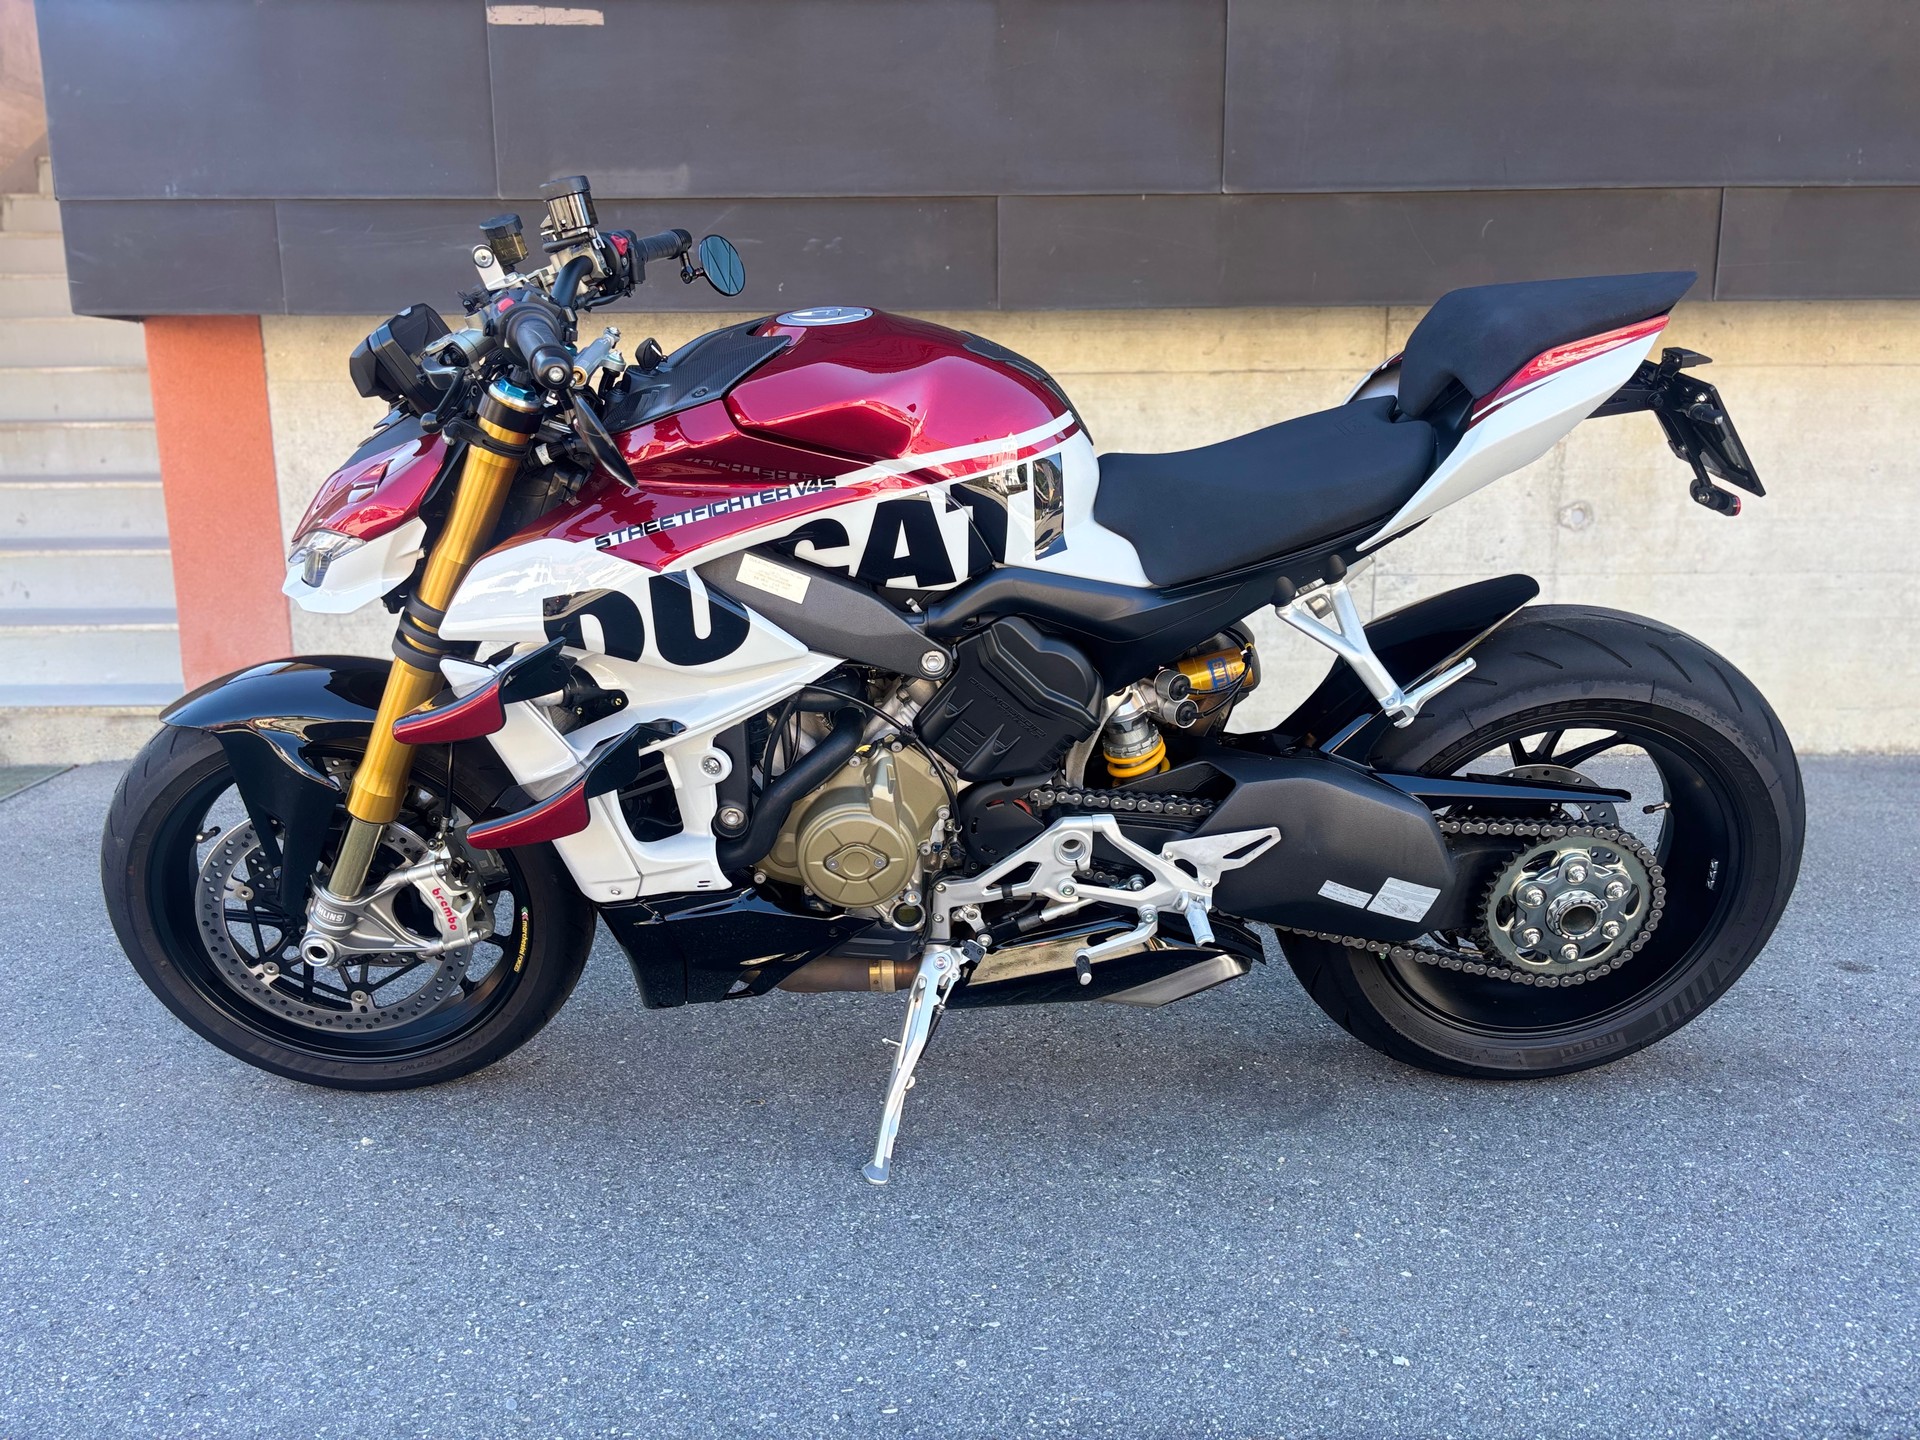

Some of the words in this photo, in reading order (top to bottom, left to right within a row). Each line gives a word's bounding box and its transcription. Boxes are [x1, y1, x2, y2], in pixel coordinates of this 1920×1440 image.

[594, 486, 792, 550] STREETFIGHTER
[795, 475, 837, 497] V4S
[431, 887, 458, 931] brembo
[1560, 1031, 1628, 1063] PIRELLI
